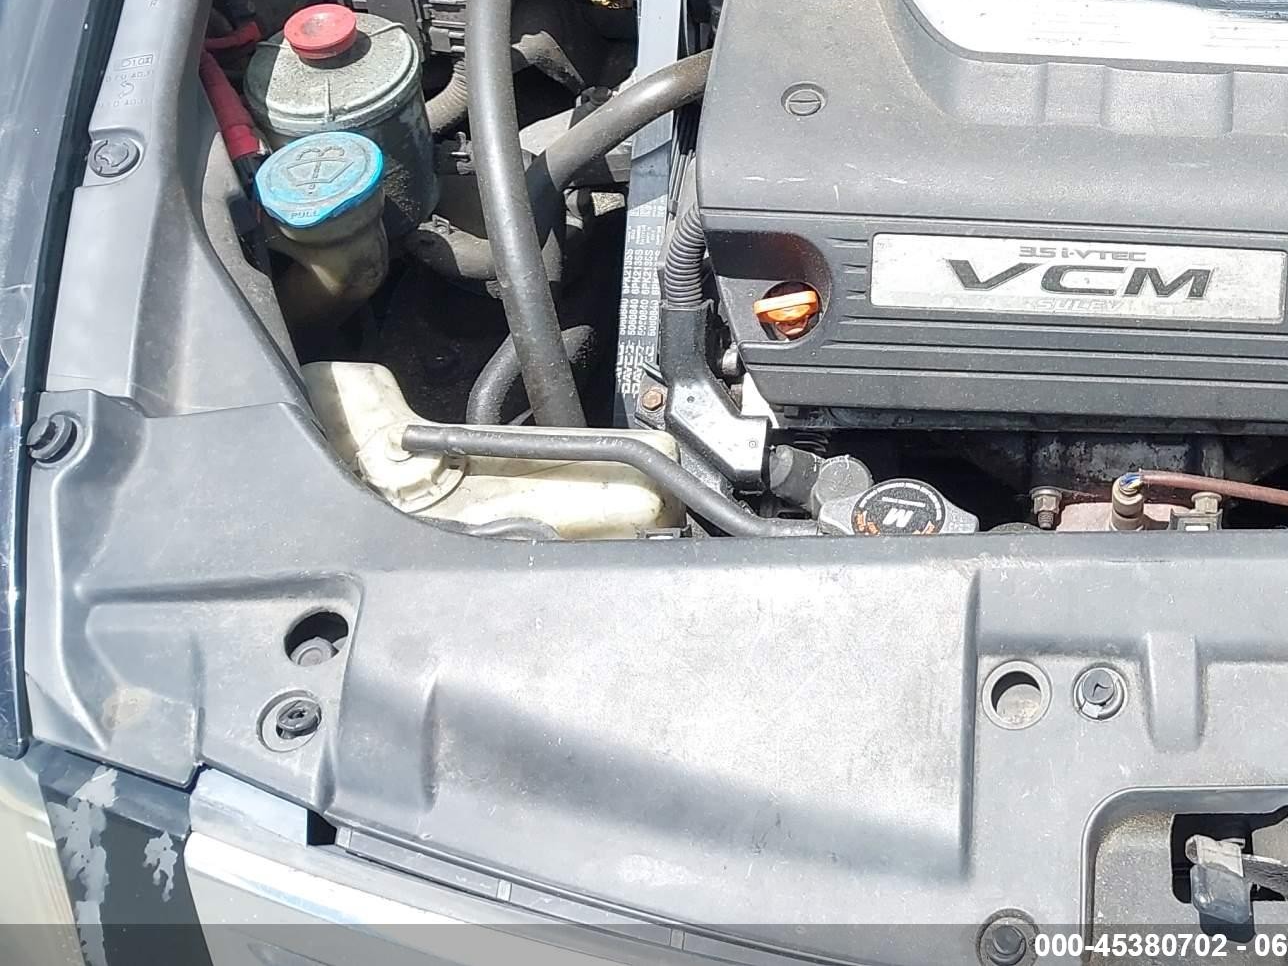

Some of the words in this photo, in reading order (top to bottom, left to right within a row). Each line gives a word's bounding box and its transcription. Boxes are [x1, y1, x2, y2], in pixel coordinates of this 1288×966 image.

[290, 209, 321, 220] PULL
[1061, 248, 1147, 262] i-VTEC
[949, 257, 1215, 299] VCM
